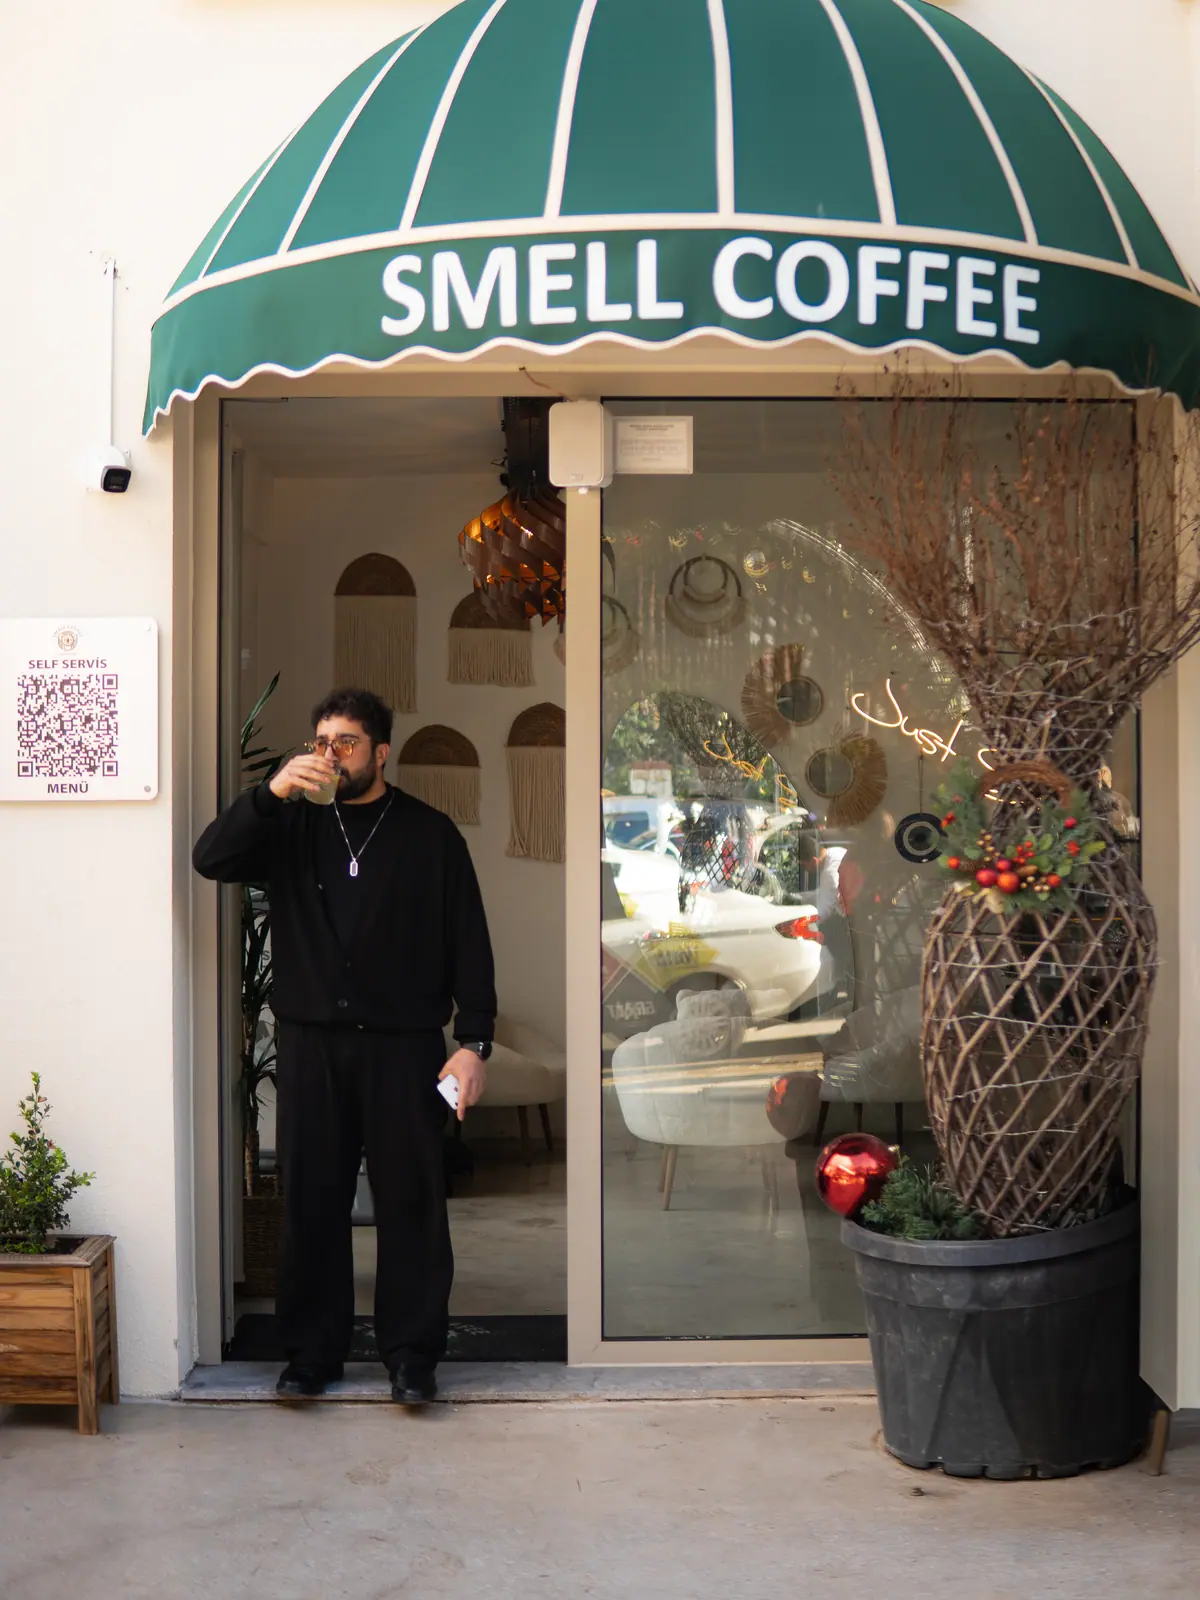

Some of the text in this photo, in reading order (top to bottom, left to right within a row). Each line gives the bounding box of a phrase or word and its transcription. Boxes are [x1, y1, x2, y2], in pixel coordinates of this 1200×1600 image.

[381, 236, 1041, 344] SMELL COFFEE
[28, 656, 107, 669] SELF SERVİS
[851, 678, 964, 762] Just
[47, 781, 89, 794] MENÜ
